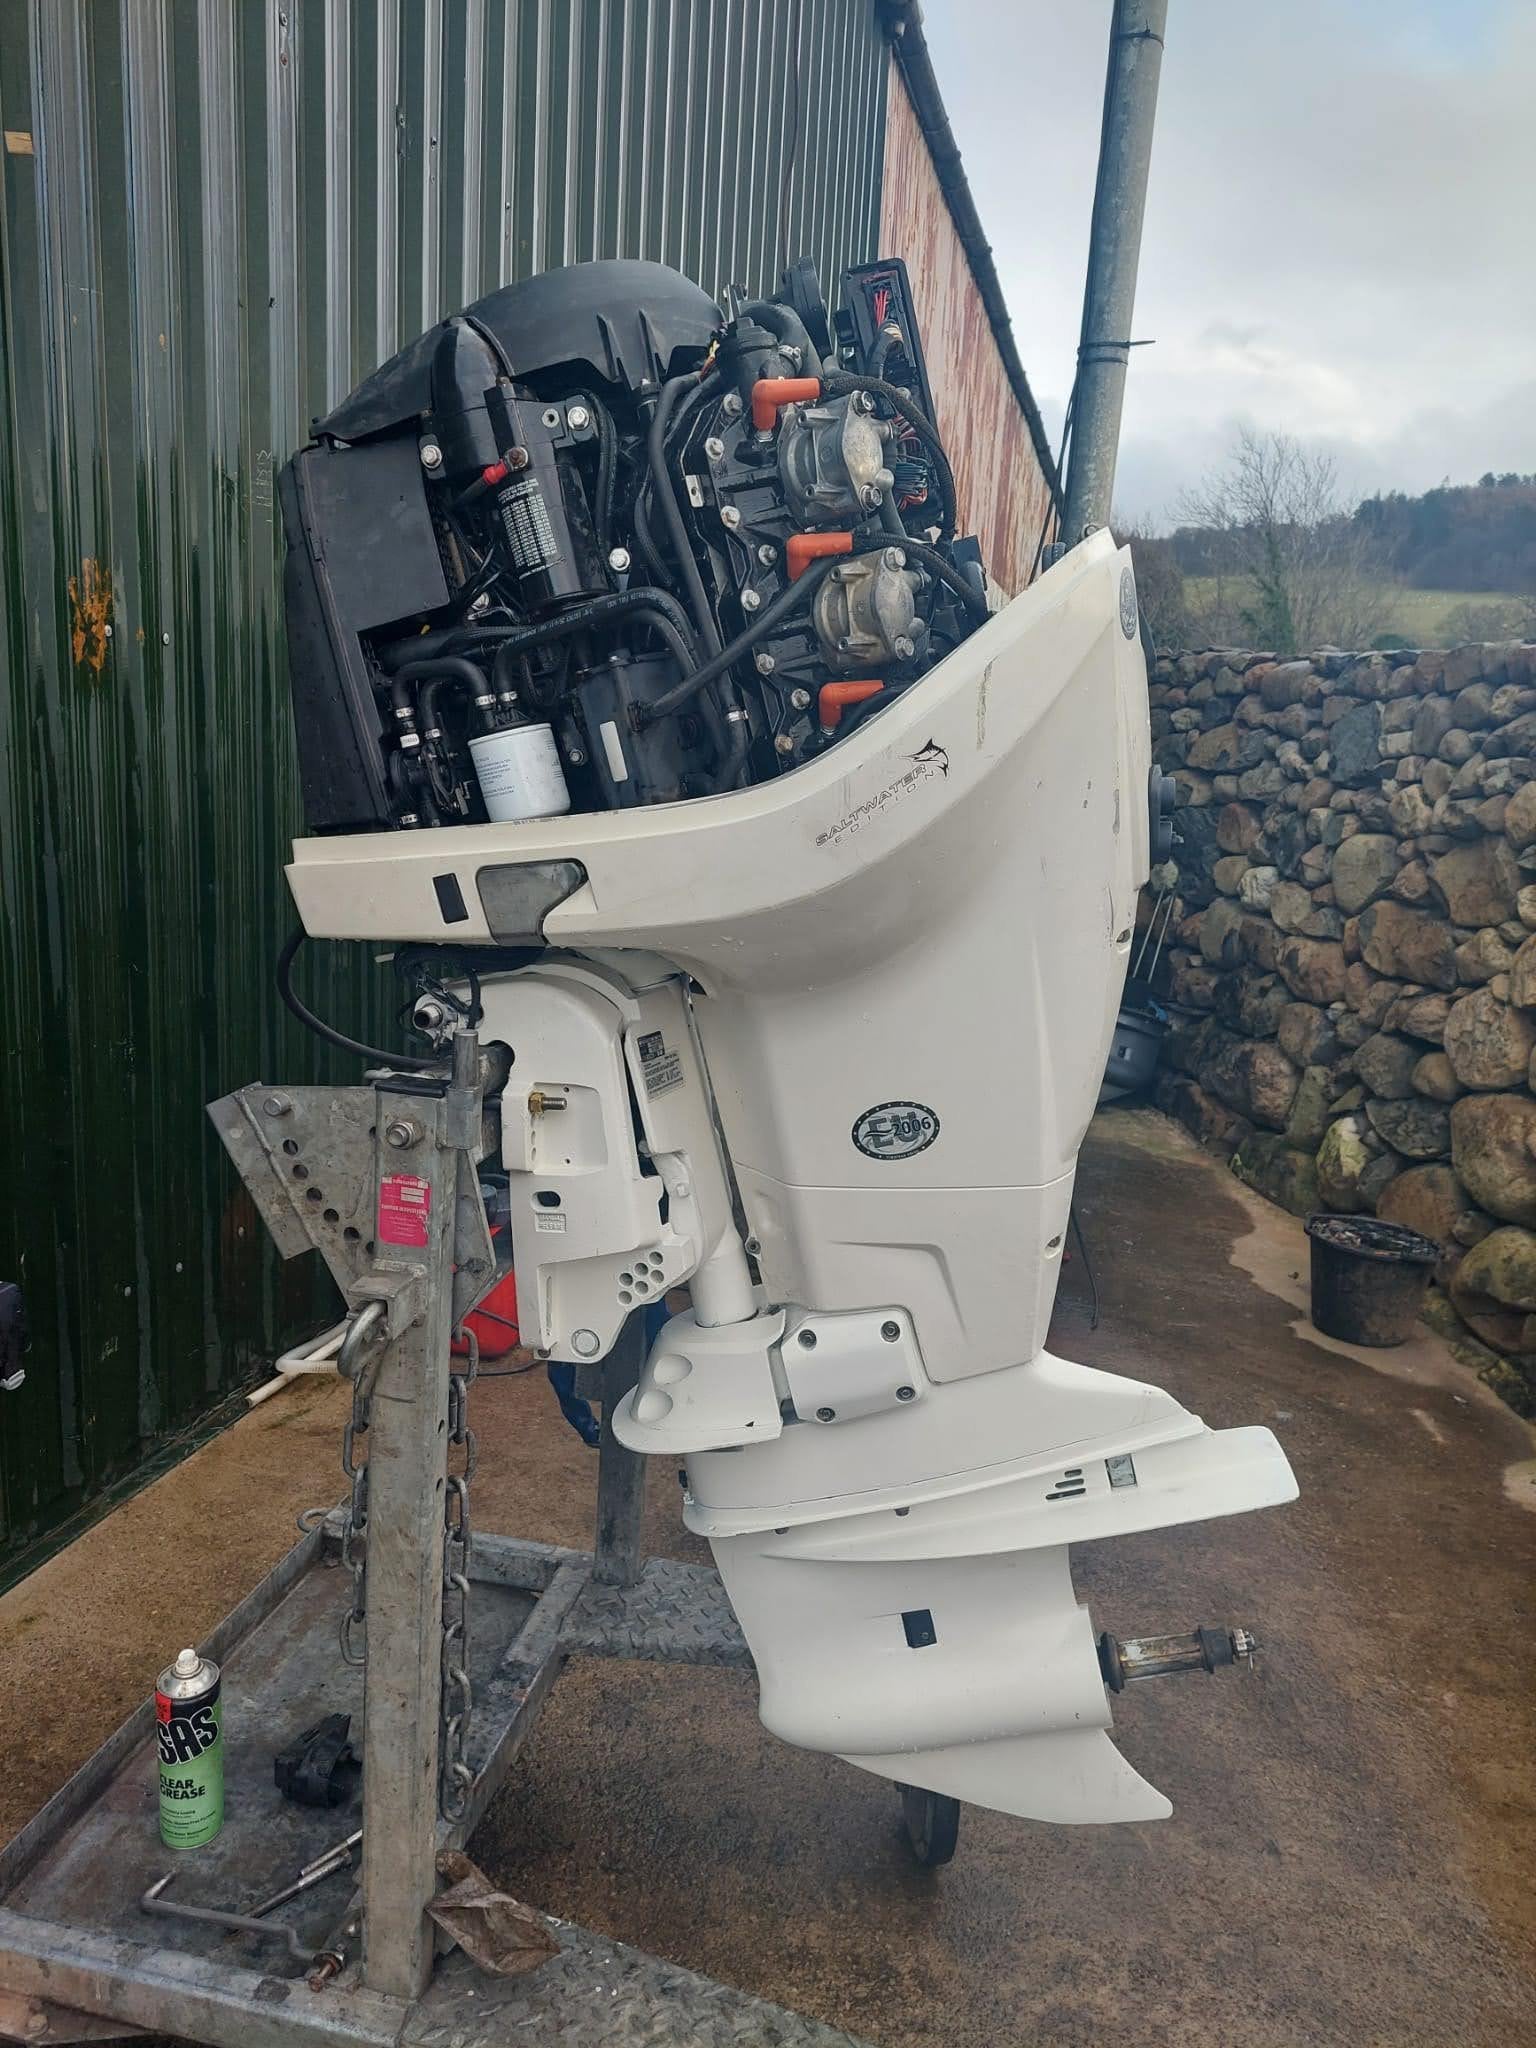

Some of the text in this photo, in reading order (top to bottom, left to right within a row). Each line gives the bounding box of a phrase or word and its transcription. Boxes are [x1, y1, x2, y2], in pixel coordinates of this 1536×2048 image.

[815, 763, 926, 846] SALTWATER
[834, 770, 935, 844] EDITION
[891, 1116, 932, 1137] 2006
[160, 1773, 194, 1790] CLEAR
[160, 1784, 206, 1800] GREASE
